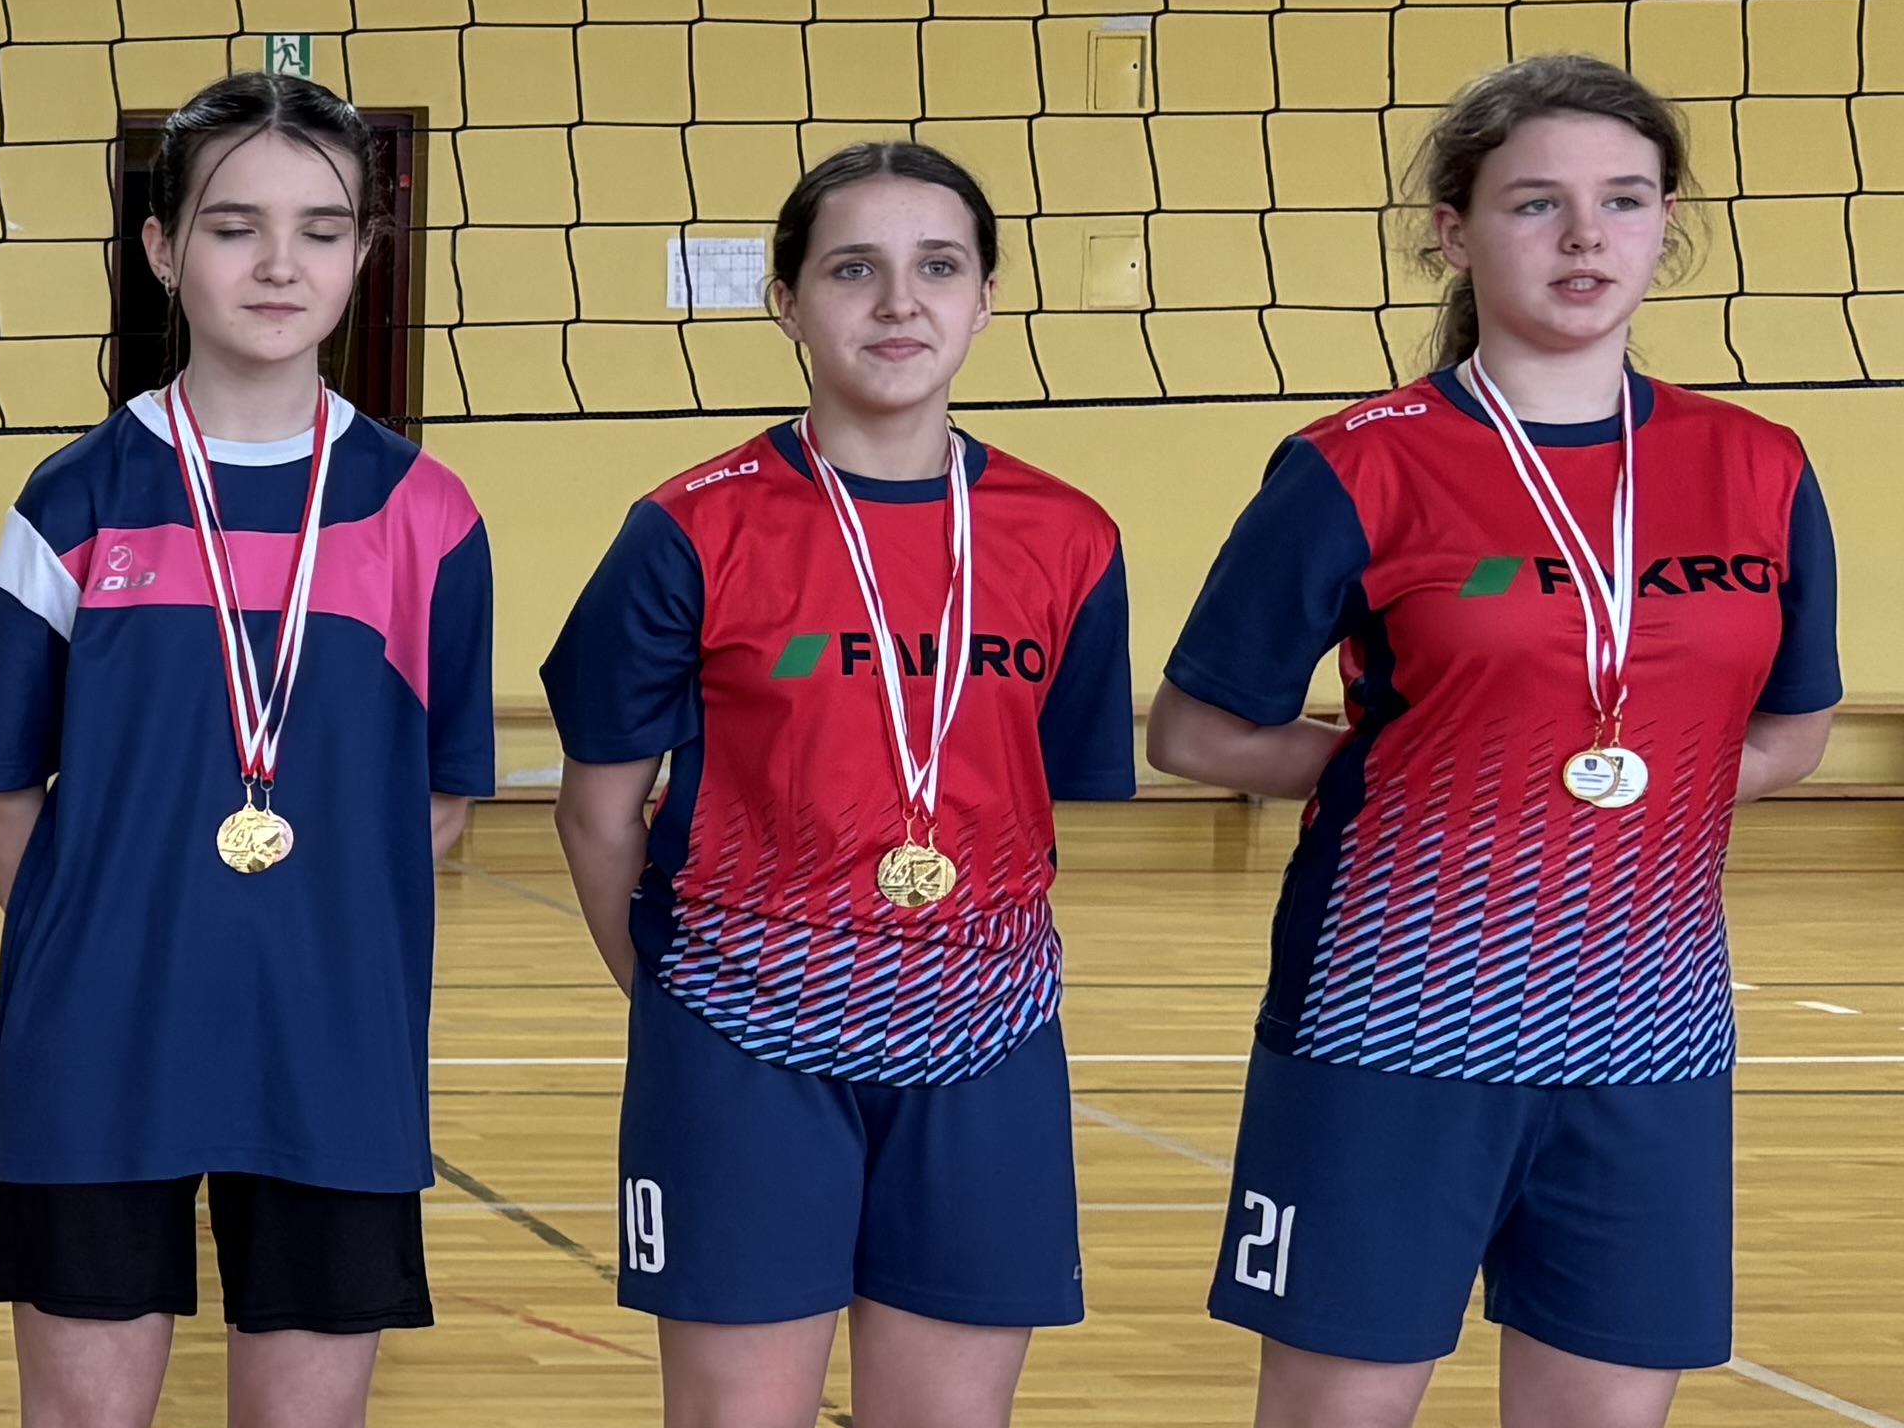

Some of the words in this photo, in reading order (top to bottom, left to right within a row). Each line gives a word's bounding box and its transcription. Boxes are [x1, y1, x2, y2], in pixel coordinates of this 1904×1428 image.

[1346, 403, 1427, 431] COLO
[686, 460, 759, 491] COLO
[1534, 554, 1781, 597] FKRO
[626, 1177, 665, 1273] 19
[1235, 1190, 1296, 1297] 21
